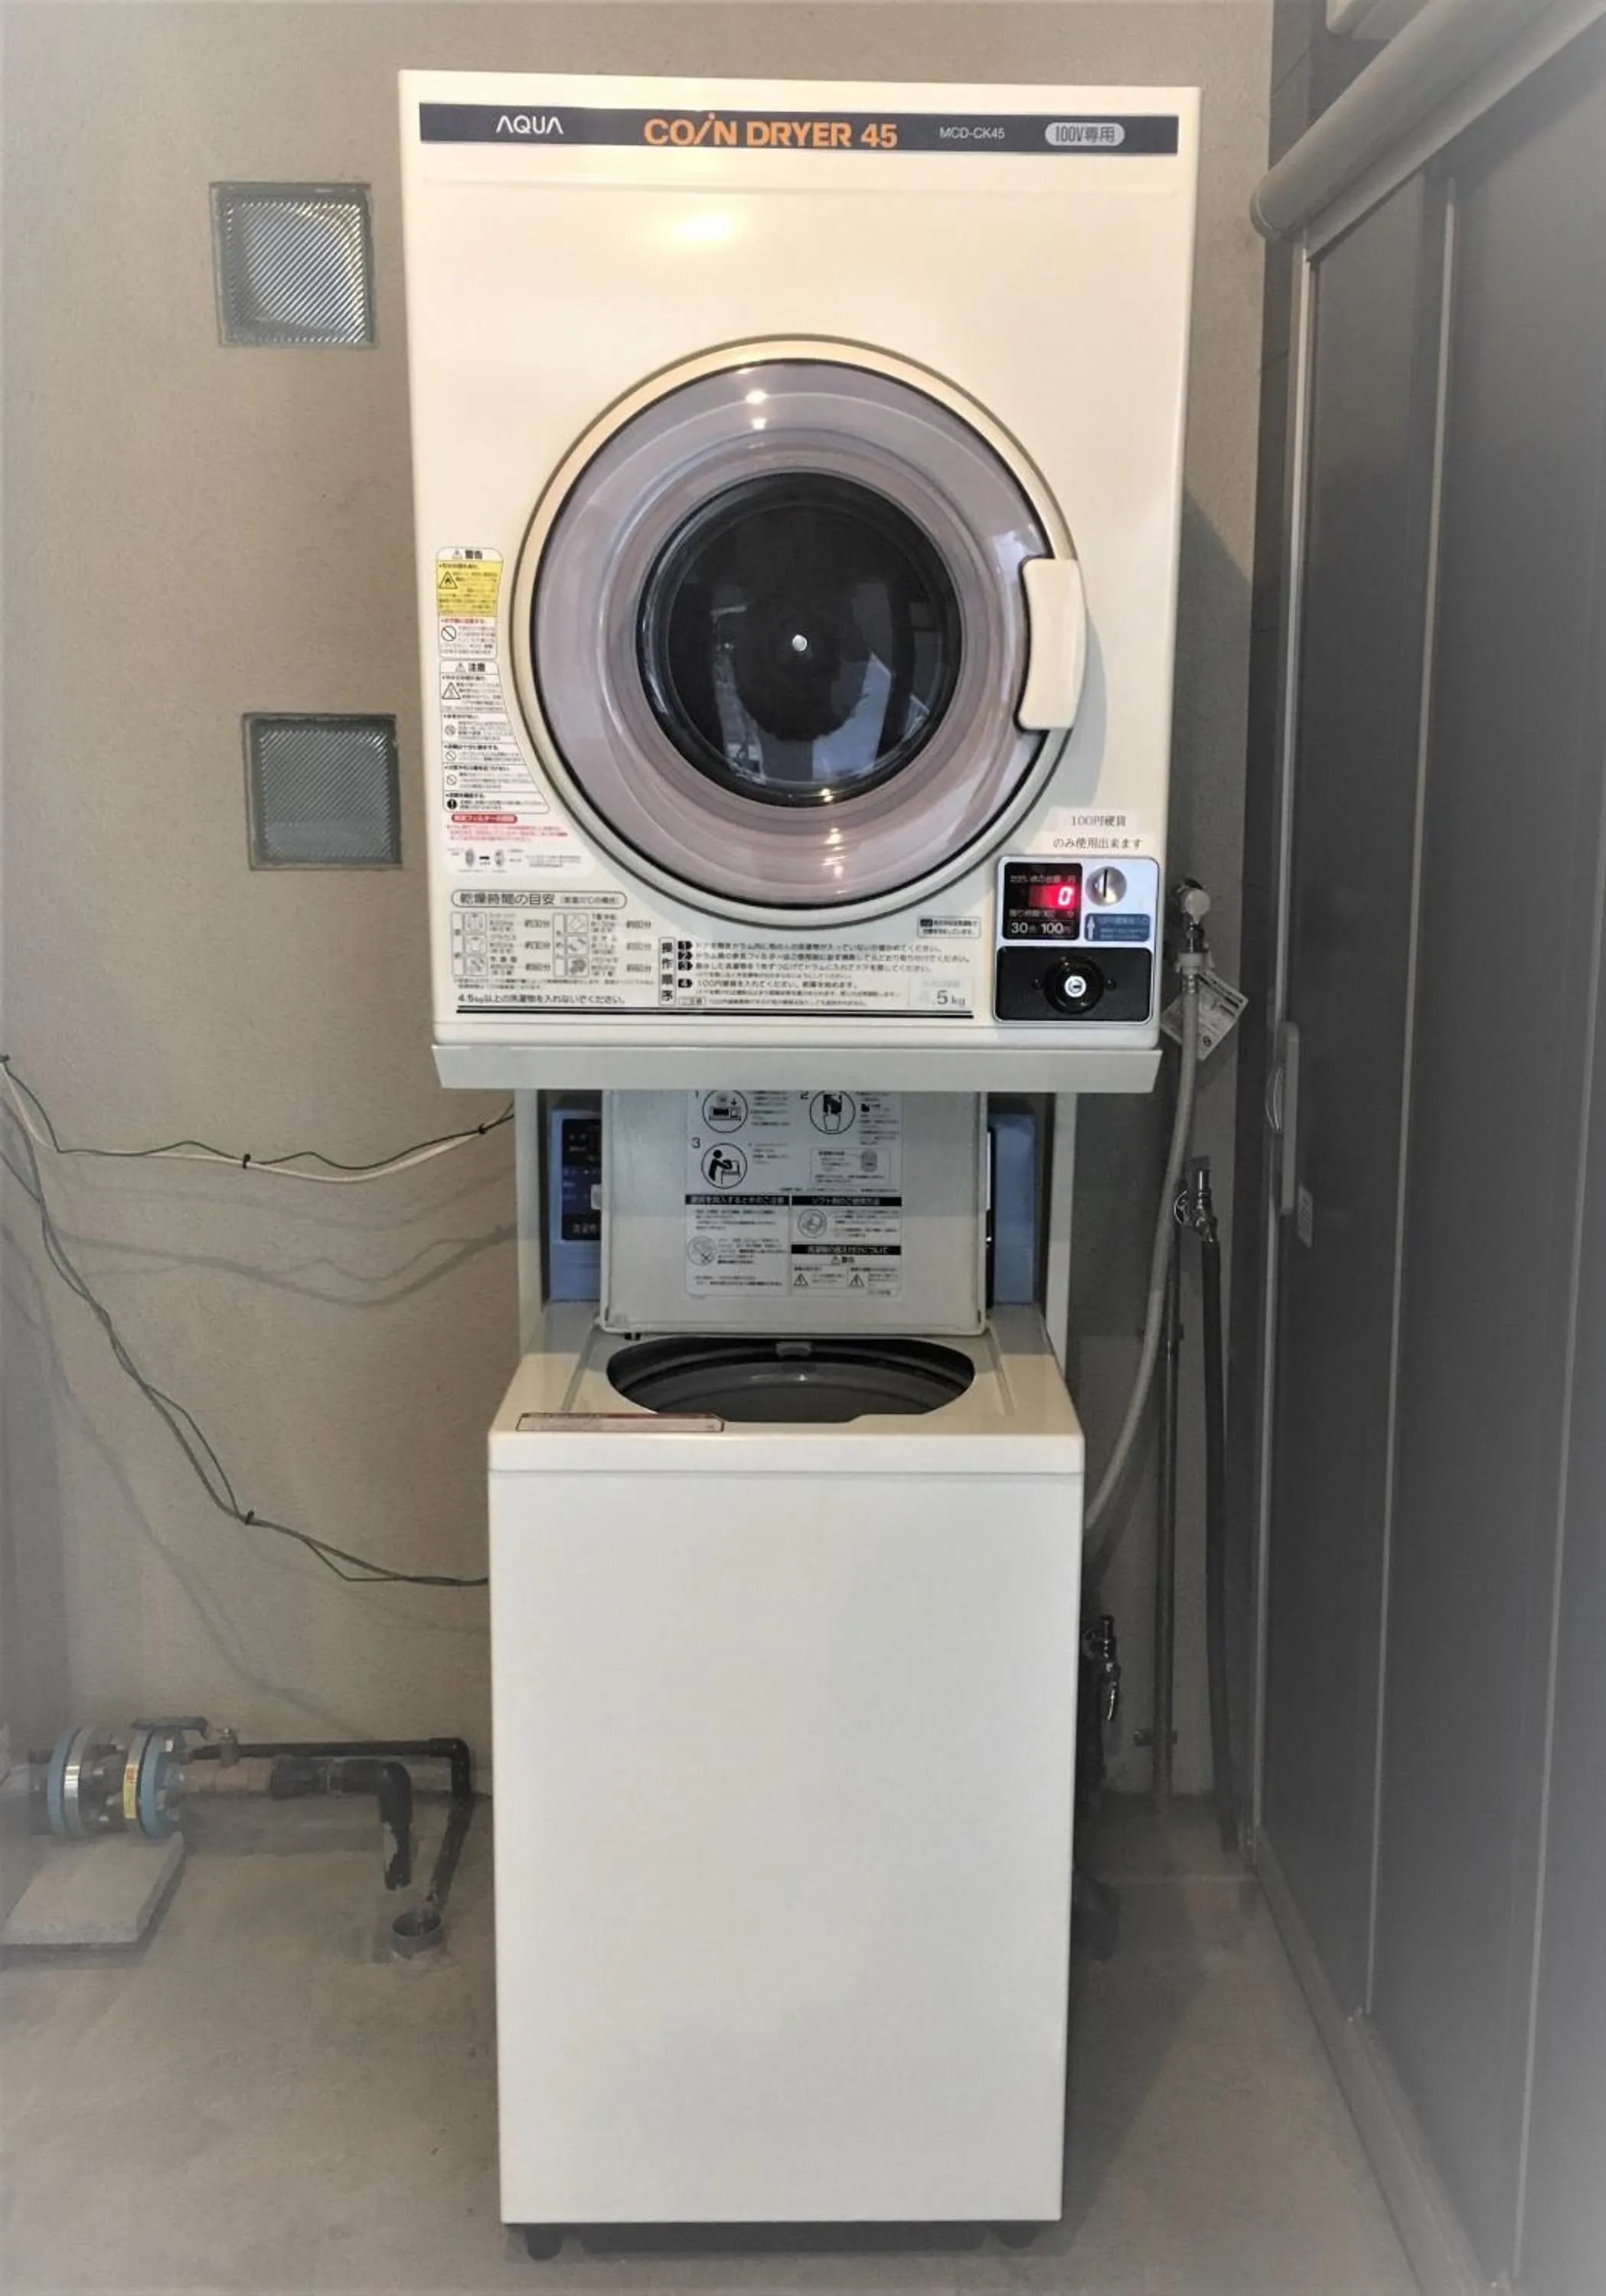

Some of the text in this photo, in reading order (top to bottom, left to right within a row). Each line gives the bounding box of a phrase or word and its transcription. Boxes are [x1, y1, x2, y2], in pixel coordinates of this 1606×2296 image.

[495, 115, 564, 135] AQUA
[746, 120, 851, 148] DRYER
[861, 122, 898, 149] 45
[939, 126, 1006, 141] MCD-CK45
[1055, 125, 1117, 144] 100V専用
[1072, 815, 1127, 827] 100円硬貨
[1053, 837, 1144, 850] のみ使用出来ます
[459, 892, 556, 906] 乾燥時間の目安
[1057, 886, 1074, 907] 0
[691, 1137, 701, 1149] 3
